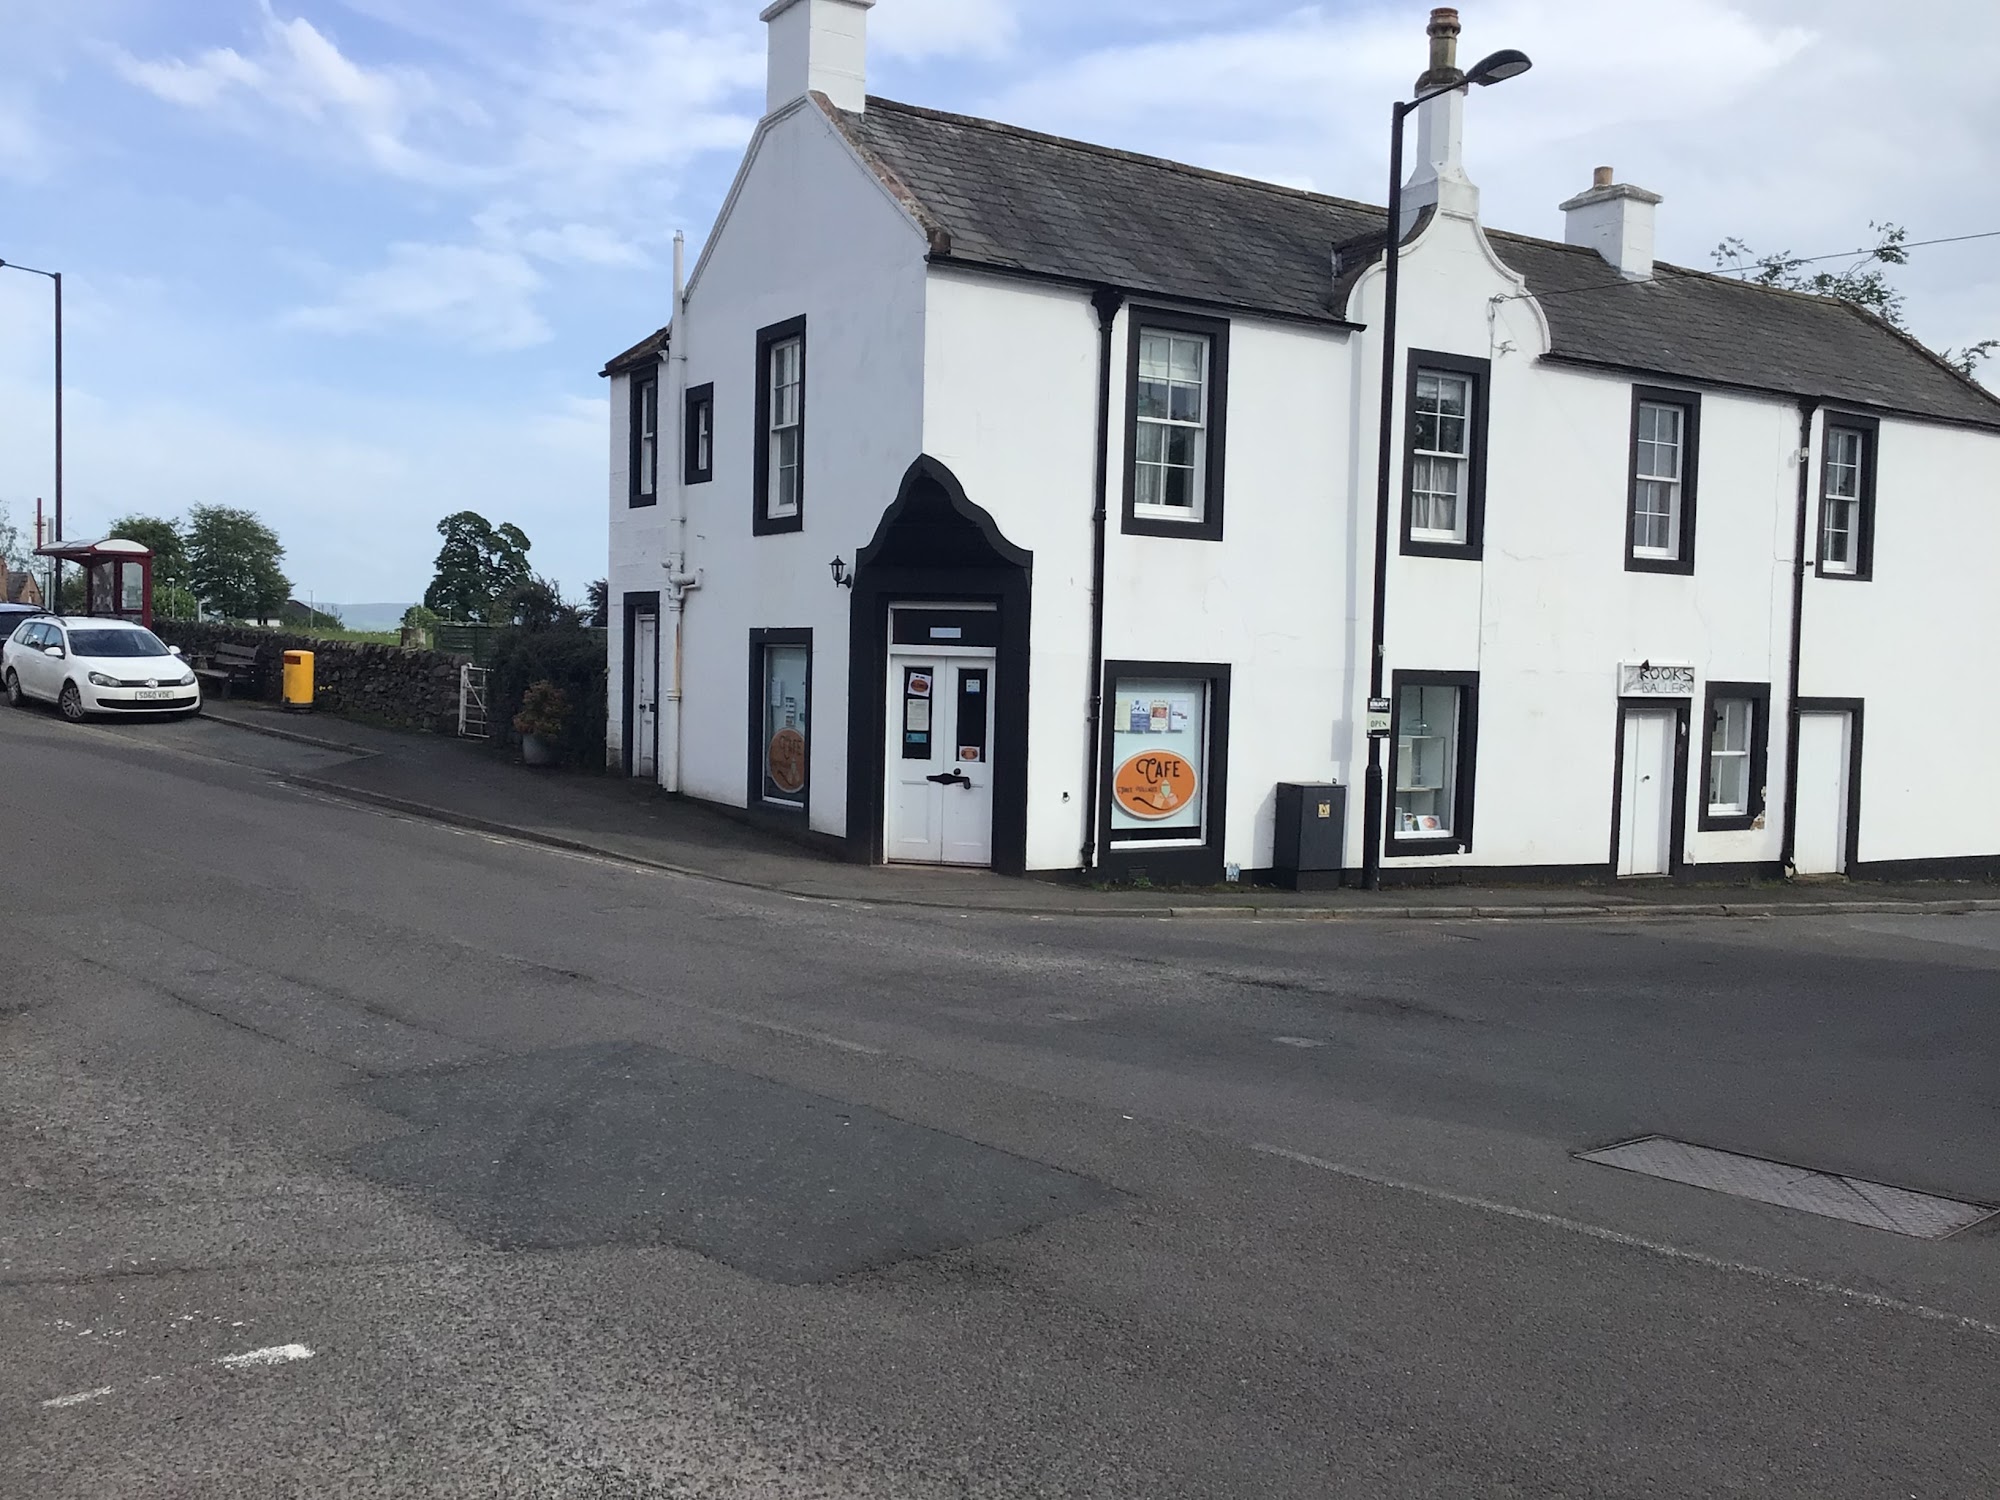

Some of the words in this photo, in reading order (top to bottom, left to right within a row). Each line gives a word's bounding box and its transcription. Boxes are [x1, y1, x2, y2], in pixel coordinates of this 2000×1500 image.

[1642, 682, 1693, 694] GALLERY
[1370, 720, 1387, 728] OPEN
[1136, 758, 1181, 784] CAFE
